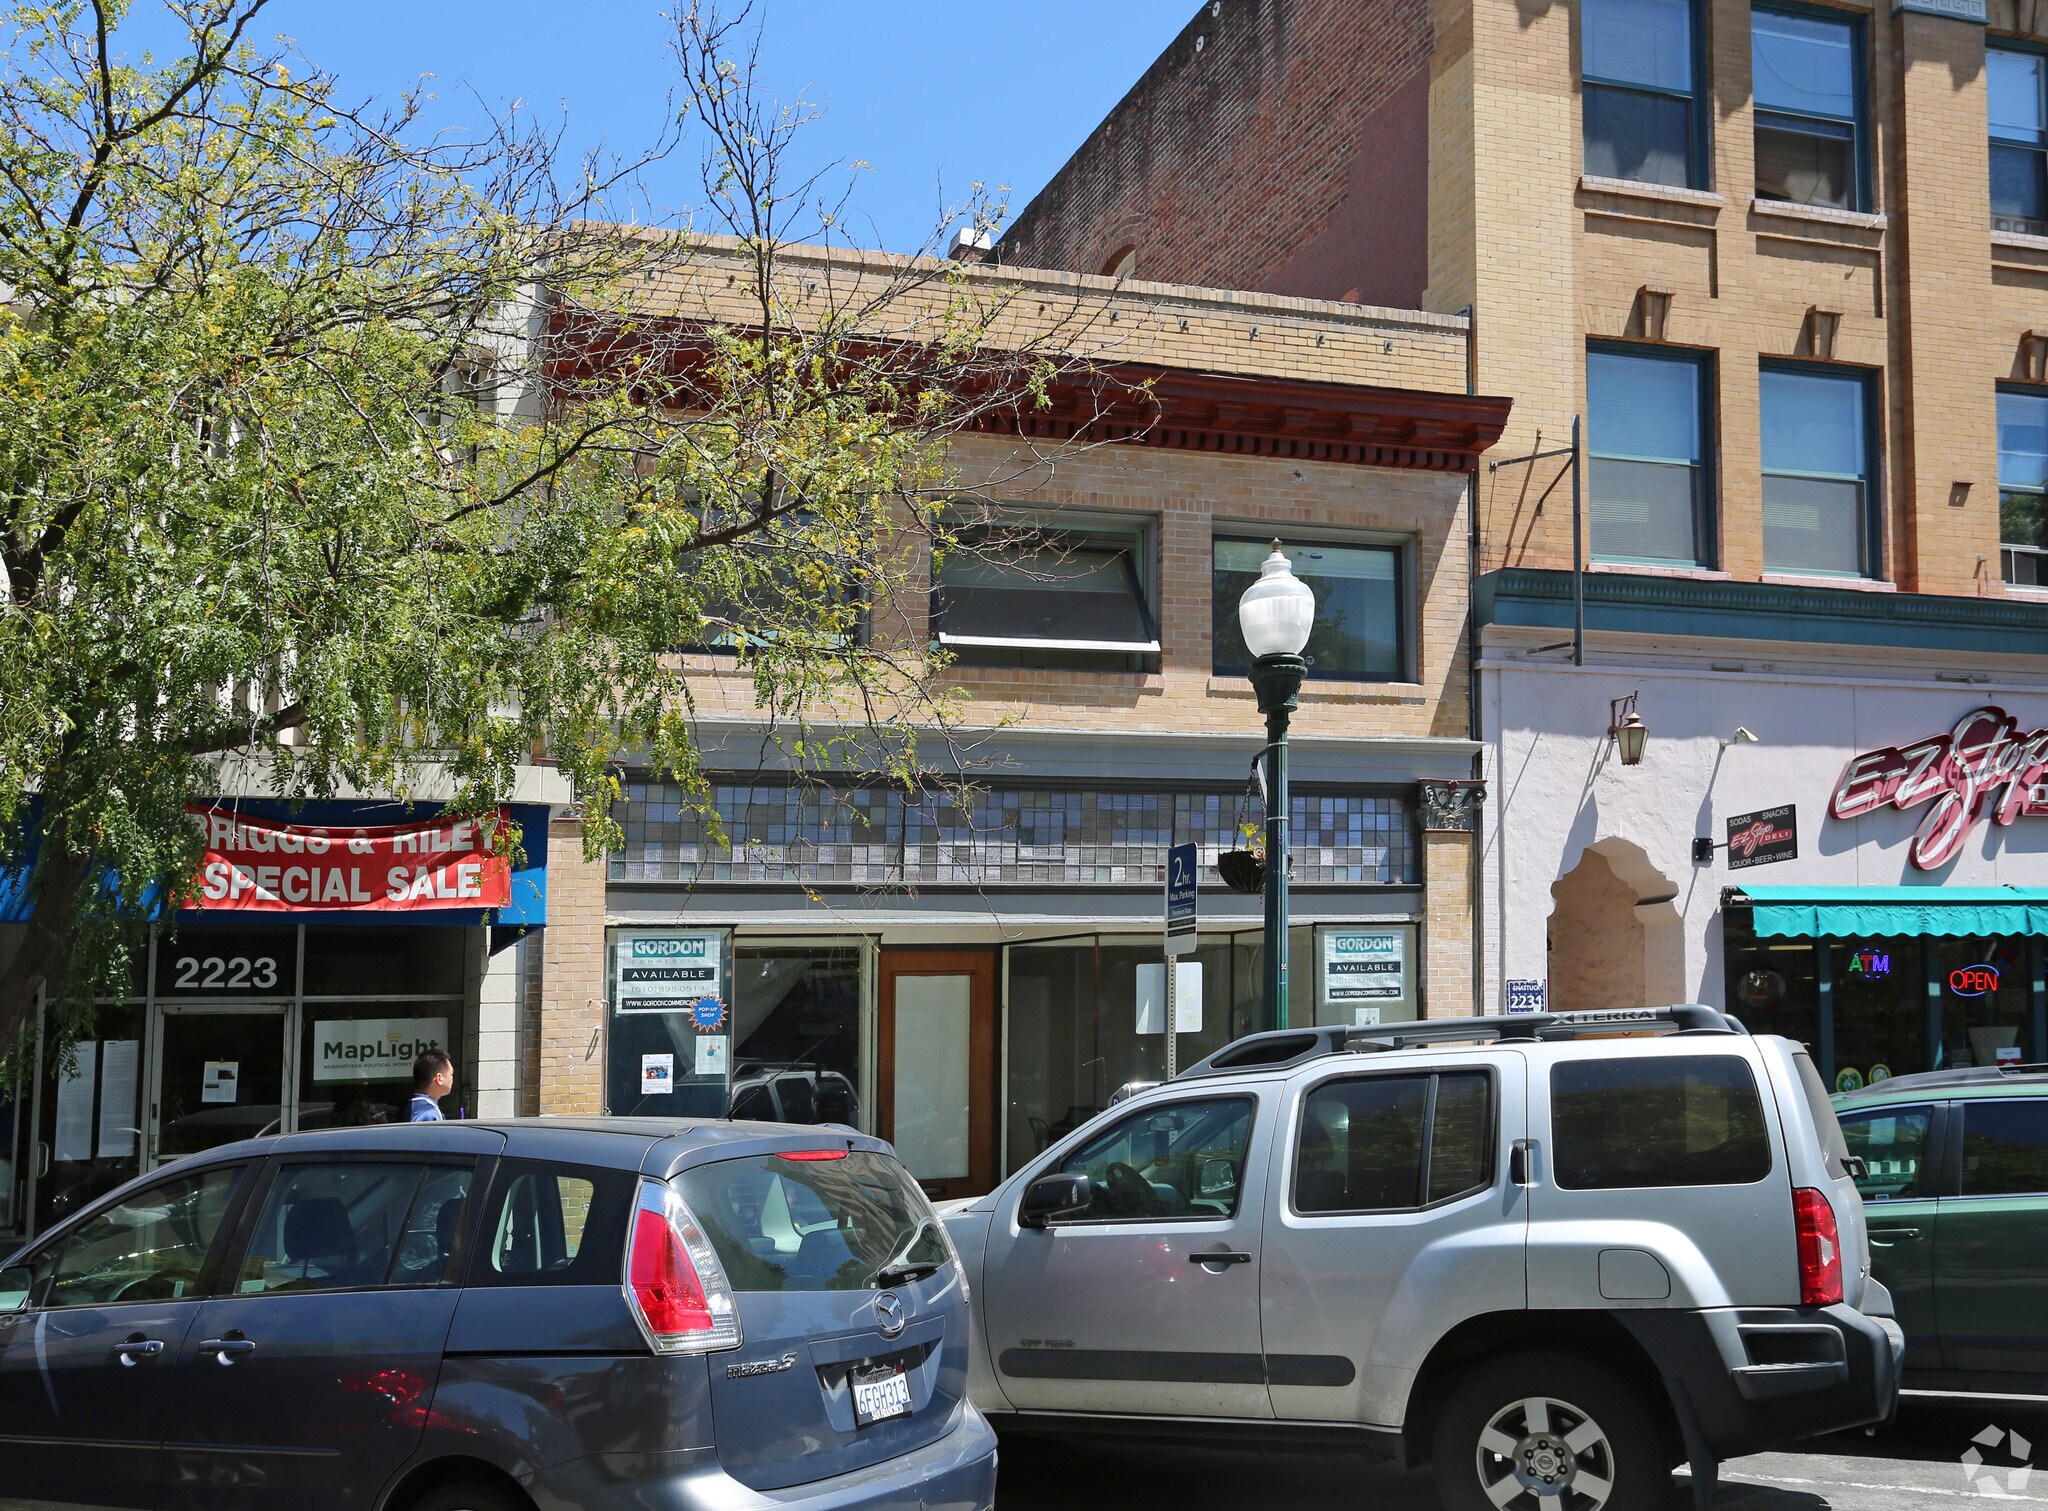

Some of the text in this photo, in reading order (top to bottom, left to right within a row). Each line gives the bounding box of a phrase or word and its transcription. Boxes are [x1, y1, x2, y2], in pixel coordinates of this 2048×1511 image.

[1729, 807, 1789, 827] SODAS SNACKS
[349, 829, 374, 855] &
[1743, 822, 1772, 855] Stop
[1764, 831, 1789, 841] DELI
[1754, 854, 1773, 864] BEER
[1775, 850, 1793, 860] WINE
[203, 862, 482, 902] SPECIAL SALE
[1169, 890, 1195, 902] Max. Parking
[634, 940, 704, 956] GORDON
[1336, 937, 1393, 952] GORDON
[174, 957, 278, 988] 2223
[1335, 963, 1394, 972] AVAILABLE
[1849, 955, 1889, 972] ATM
[631, 970, 706, 979] AVAILABLE
[1950, 970, 1998, 991] OPEN
[324, 1039, 438, 1062] MapLight
[859, 1379, 909, 1414] 6FGH313
